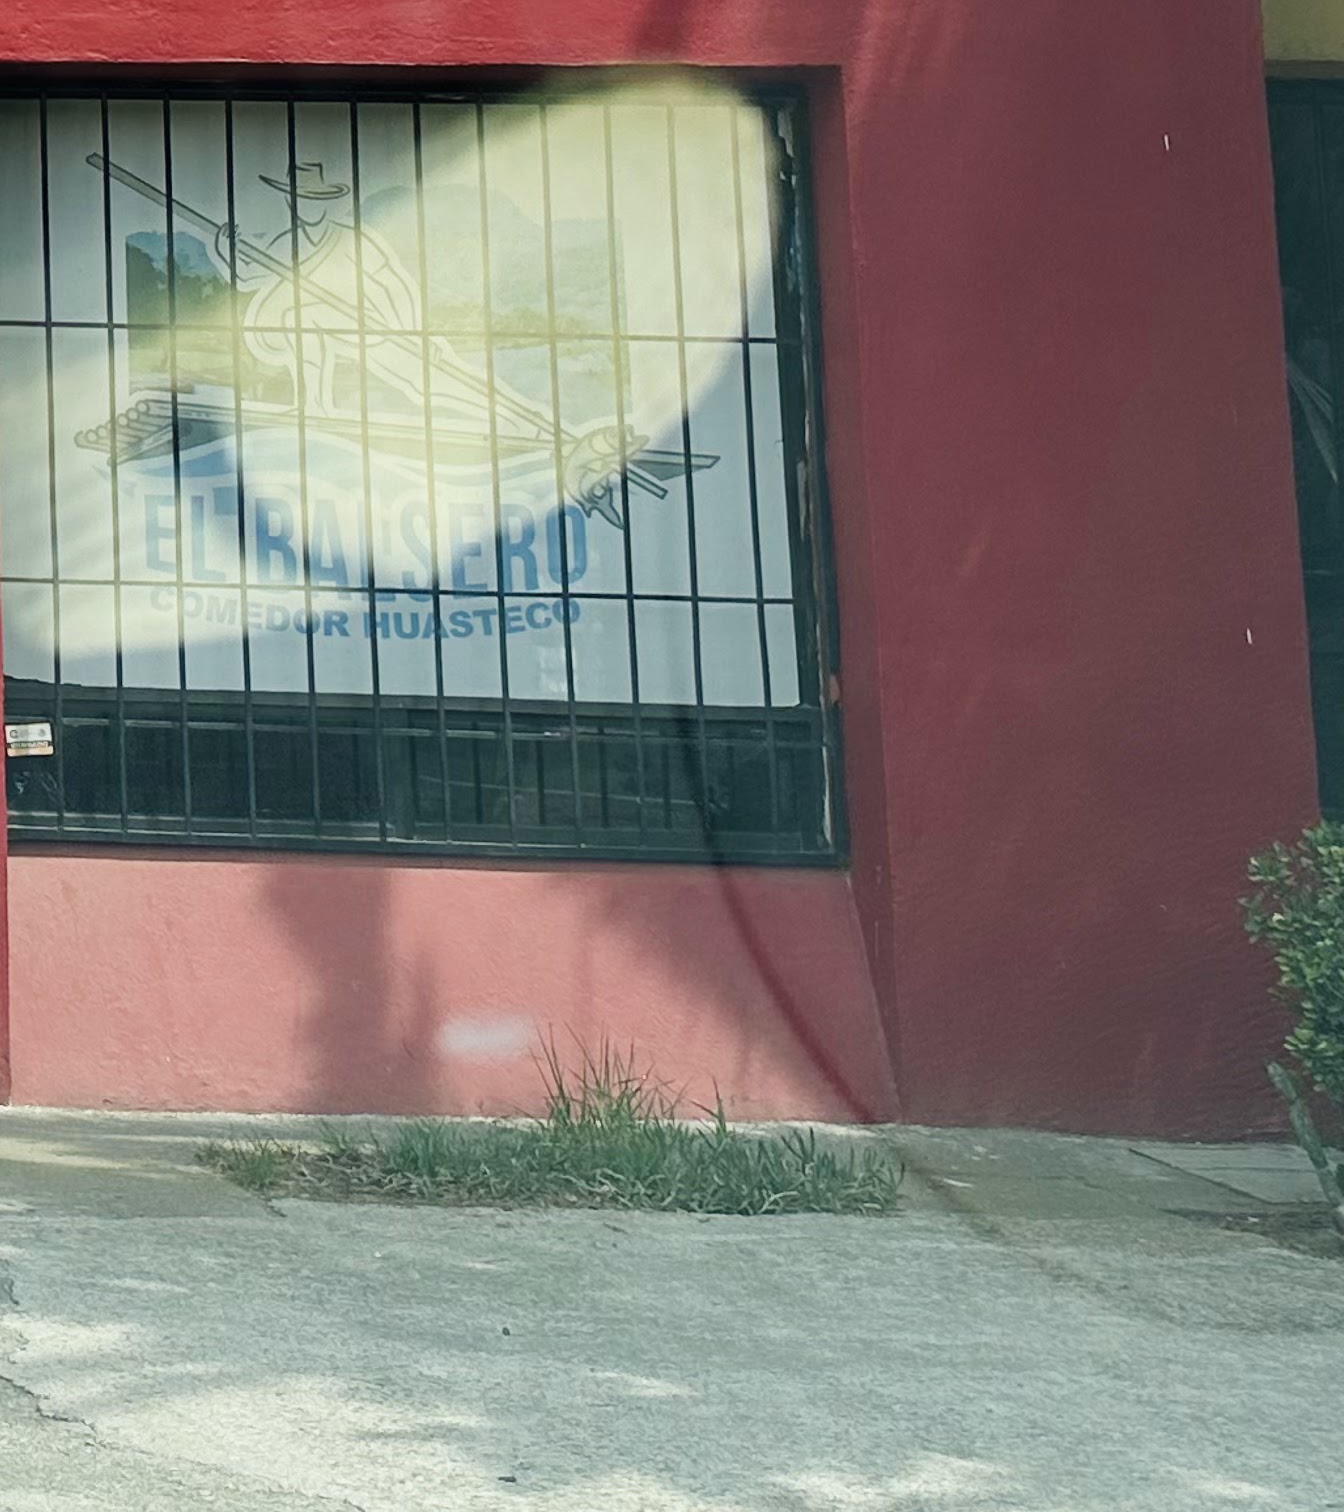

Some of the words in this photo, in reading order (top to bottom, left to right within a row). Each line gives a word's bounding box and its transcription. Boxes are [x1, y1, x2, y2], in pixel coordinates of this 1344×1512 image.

[144, 493, 226, 581] EL
[255, 496, 588, 603] BALSERO
[151, 590, 350, 637] COMEDOR
[364, 600, 581, 639] HUASTECO
